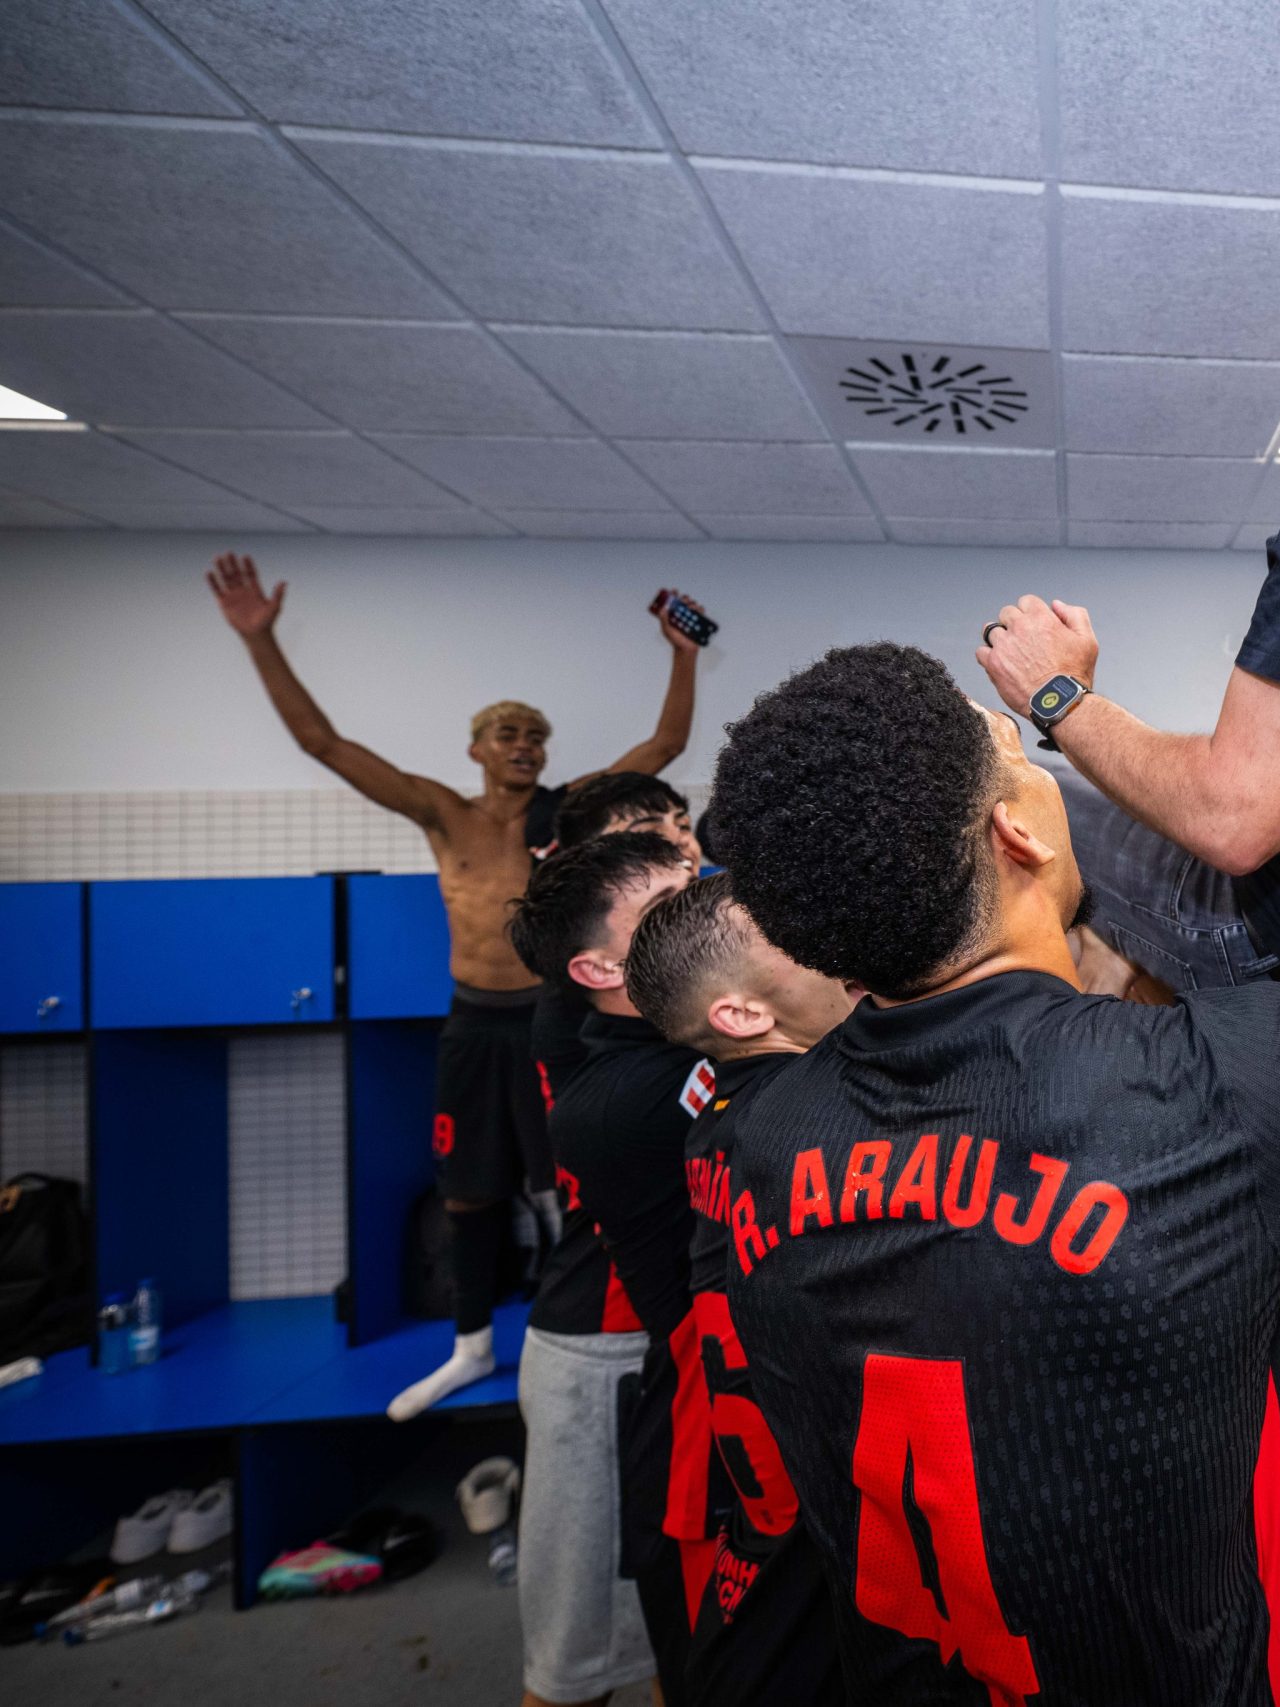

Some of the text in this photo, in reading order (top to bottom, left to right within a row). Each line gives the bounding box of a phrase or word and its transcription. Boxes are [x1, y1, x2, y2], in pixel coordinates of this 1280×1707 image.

[731, 1133, 1130, 1277] R. ARAUJO
[852, 1353, 1041, 1707] 4
